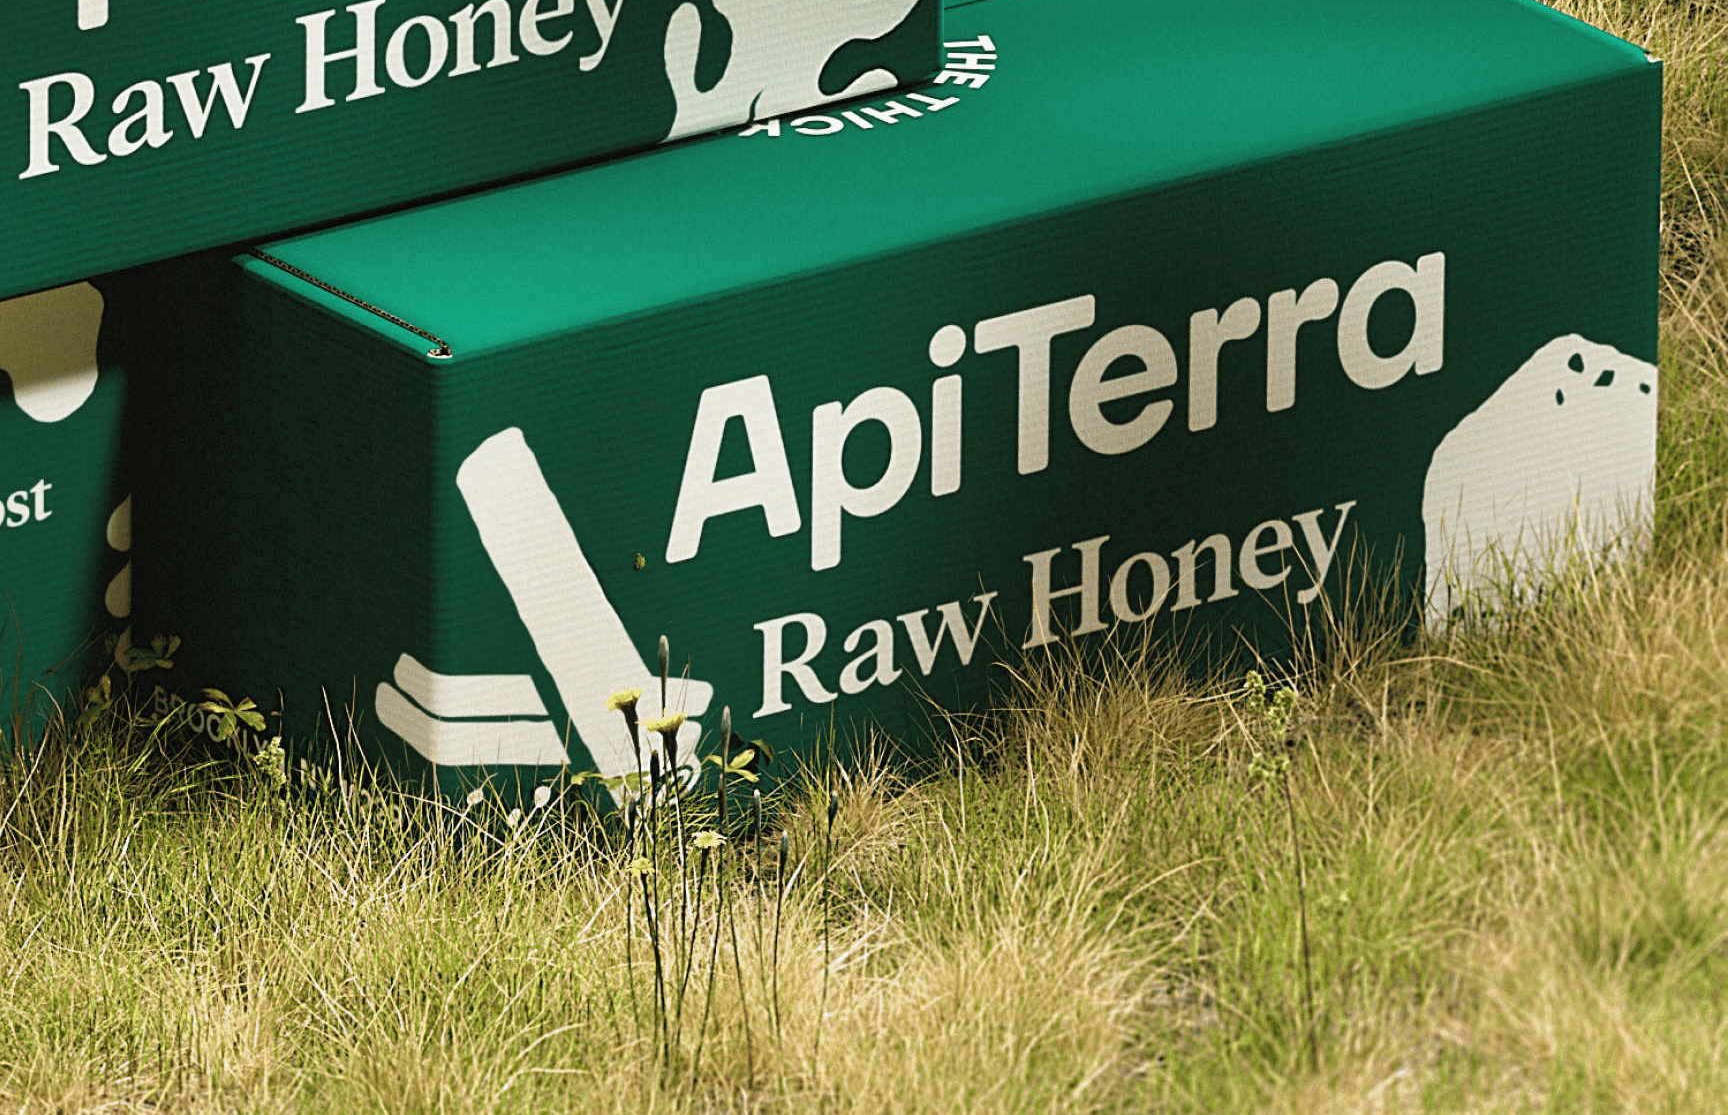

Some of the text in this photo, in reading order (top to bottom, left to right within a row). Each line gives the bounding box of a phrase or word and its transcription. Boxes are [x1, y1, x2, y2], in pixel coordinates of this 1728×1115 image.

[18, 51, 272, 180] Raw
[933, 34, 998, 89] THE
[665, 251, 1446, 571] ApiTerra
[752, 500, 1358, 719] Raw Honey
